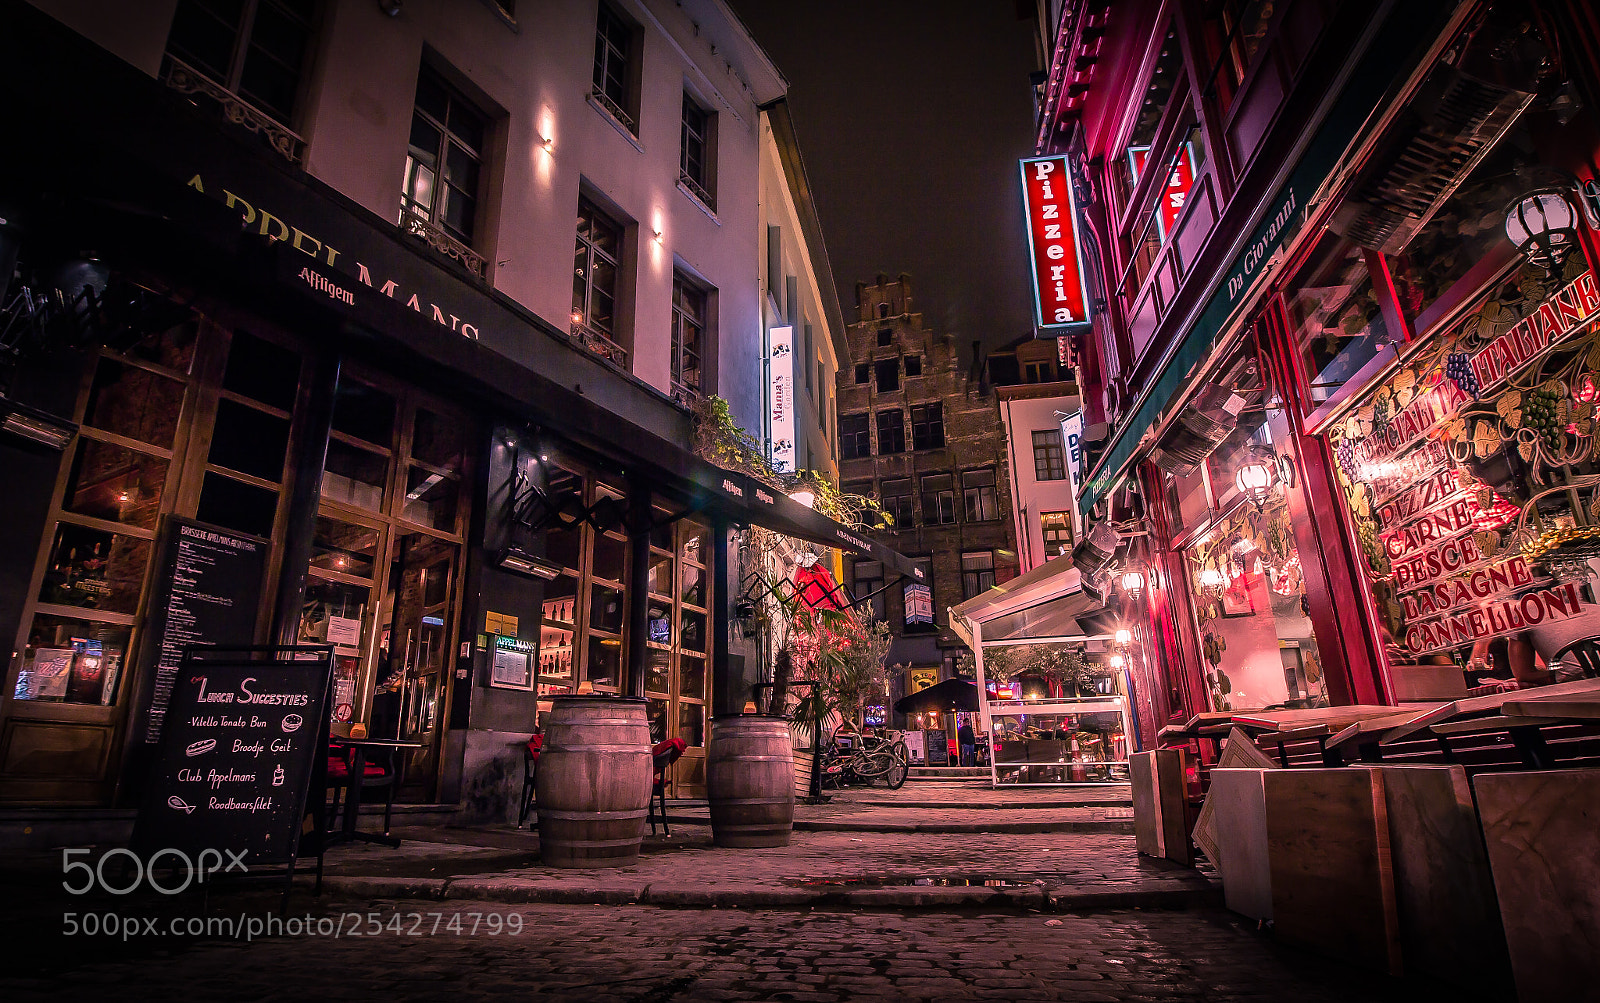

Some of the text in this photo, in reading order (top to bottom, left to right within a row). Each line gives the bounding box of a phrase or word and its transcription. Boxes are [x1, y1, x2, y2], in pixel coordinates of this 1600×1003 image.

[1034, 161, 1074, 322] Pizzeria
[1228, 187, 1297, 302] Da Giovanni
[298, 267, 355, 306] Affligem
[1469, 273, 1600, 390] ITALIANE
[772, 375, 784, 422] Mama's
[1380, 469, 1457, 529] PIZZE
[1386, 499, 1472, 560] CARNE
[1396, 536, 1480, 590] PESCE
[1402, 555, 1533, 621] LASAGNE
[496, 636, 534, 650] APPELMANS
[1406, 583, 1582, 653] CANNELLONI
[220, 715, 247, 728] Tonato
[250, 716, 267, 727] Bun
[232, 738, 291, 758] Broodje Geit
[178, 768, 256, 790] Club Appelmans
[208, 796, 273, 814] Roodbaarsfilet
